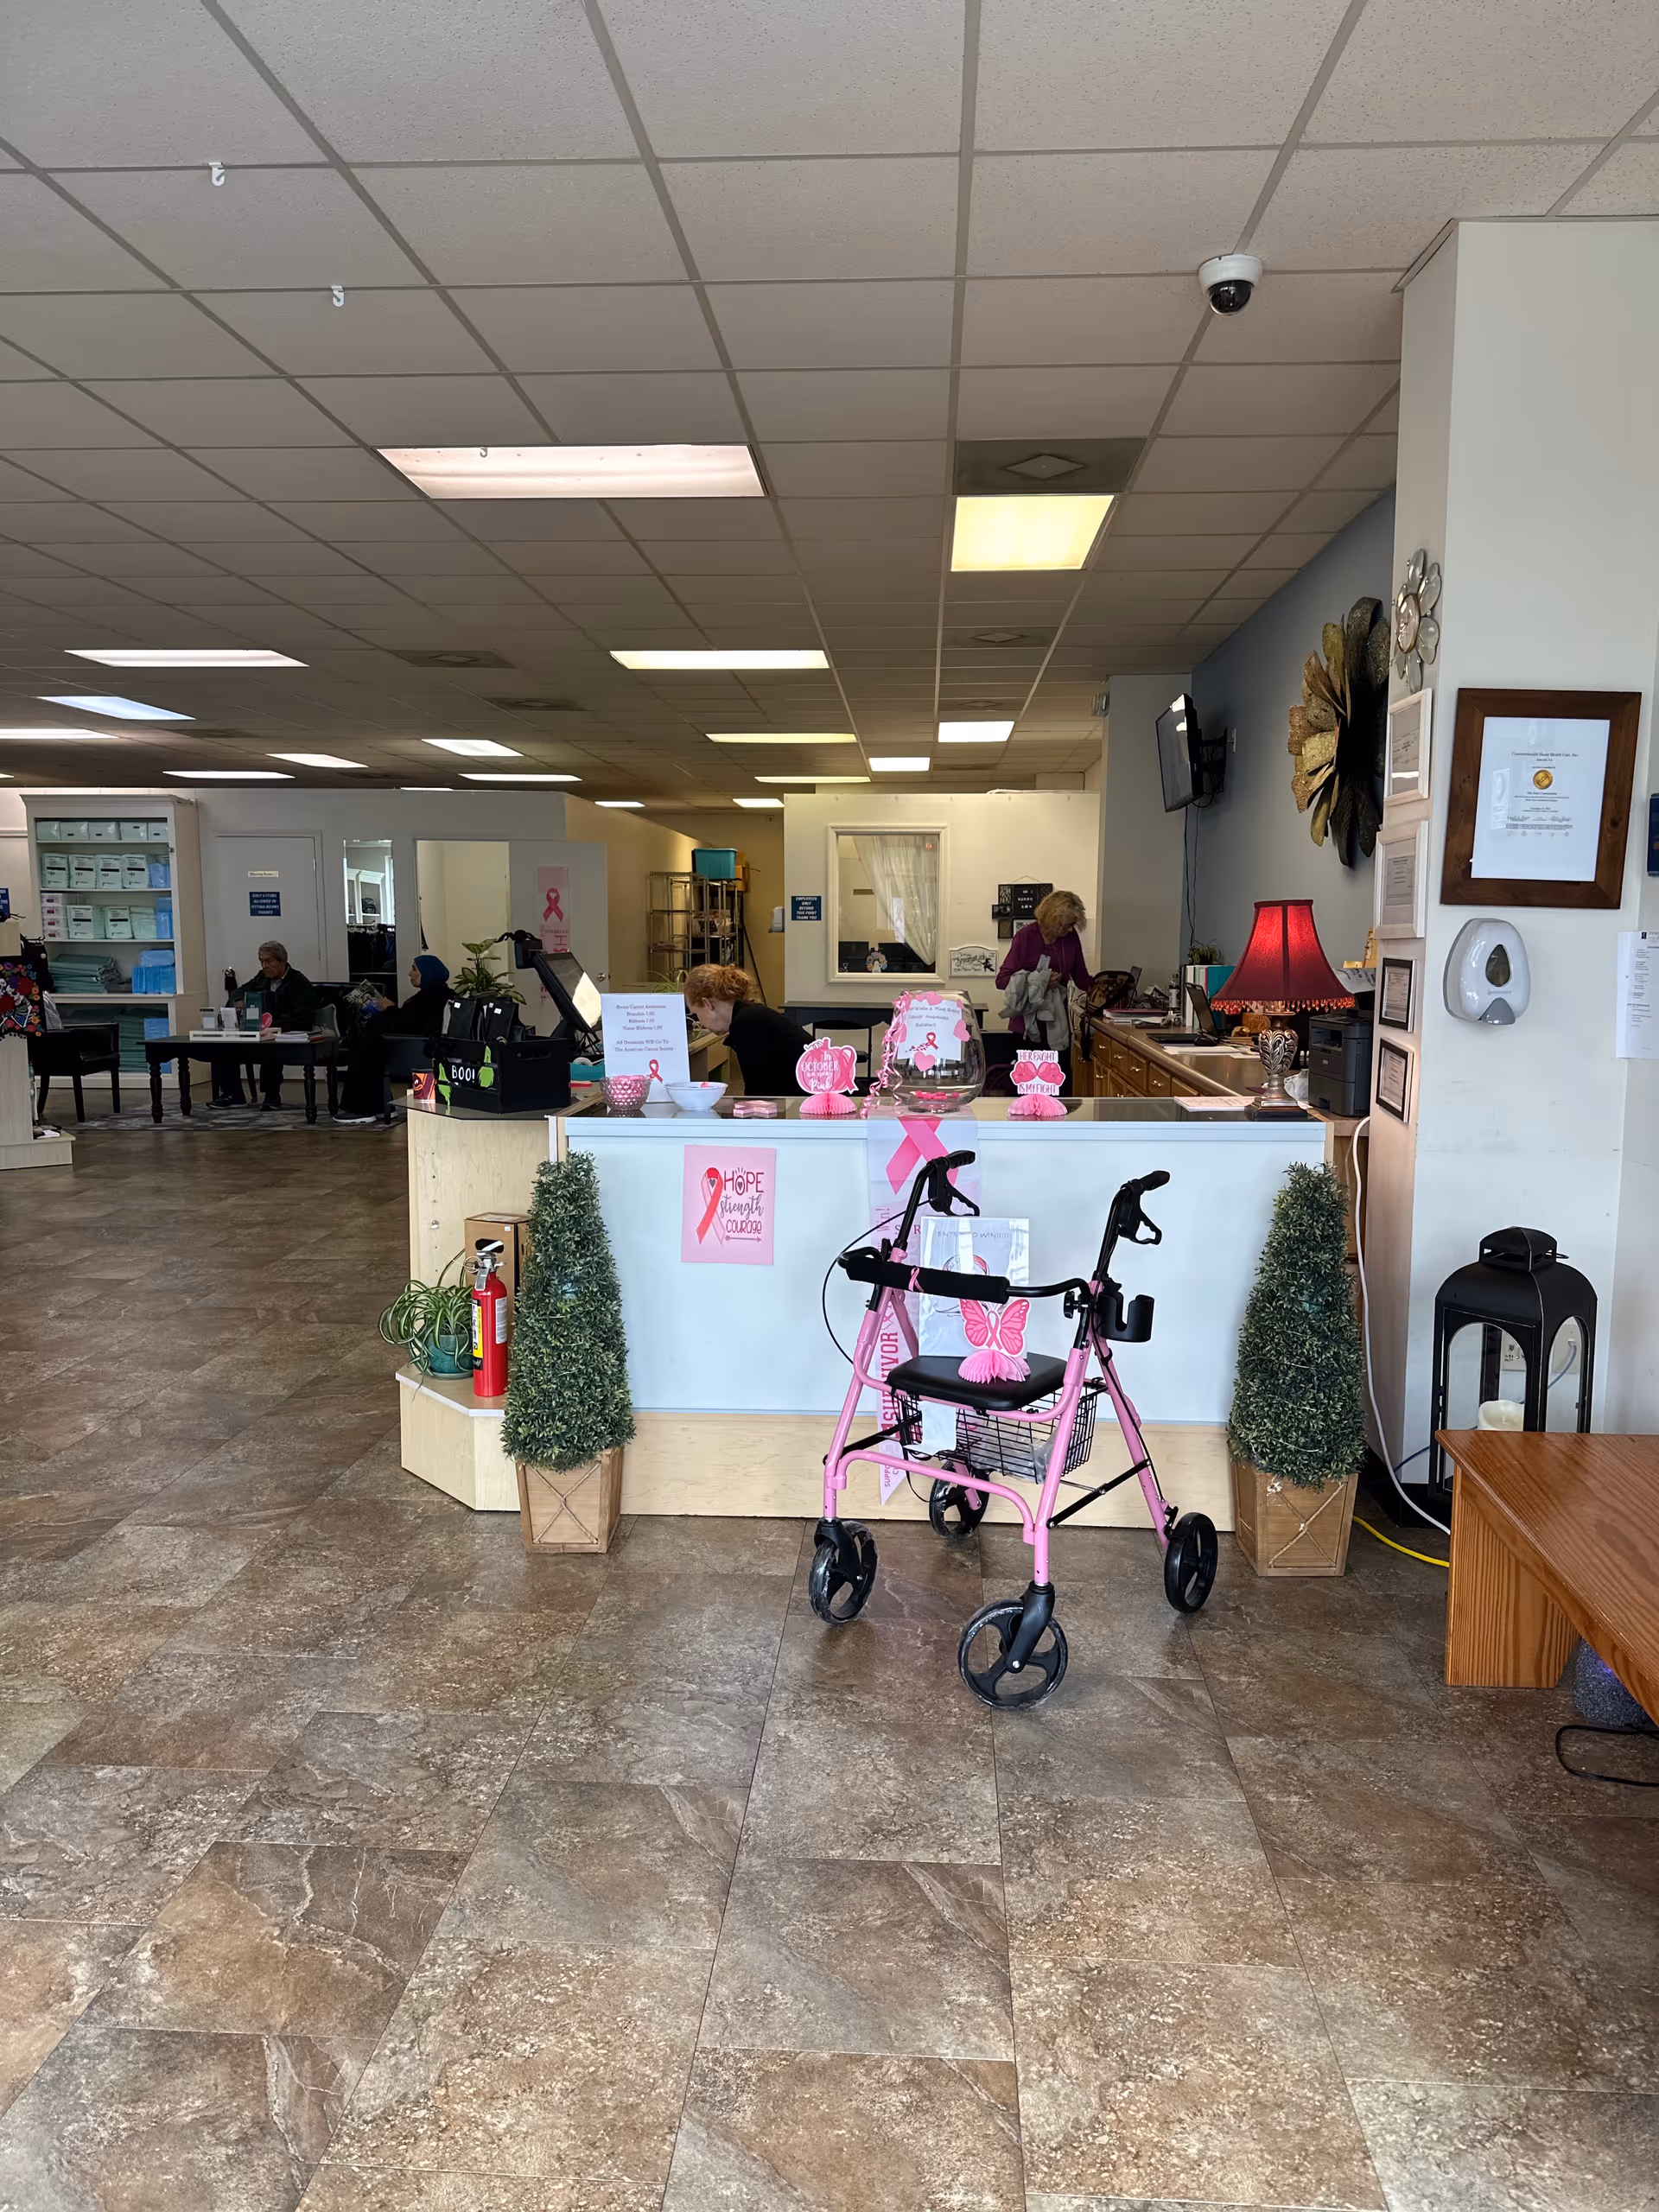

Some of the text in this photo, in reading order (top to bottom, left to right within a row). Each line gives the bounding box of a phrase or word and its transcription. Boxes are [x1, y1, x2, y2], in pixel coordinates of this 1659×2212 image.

[824, 1051, 831, 1061] In
[1020, 1052, 1033, 1061] HER
[451, 1065, 475, 1083] BOO!
[801, 1061, 839, 1071] OCTOBER
[810, 1077, 832, 1091] Pink
[1020, 1084, 1056, 1093] IS MY FIGHT
[724, 1170, 765, 1196] HOPE
[720, 1194, 764, 1220] strength
[875, 1209, 890, 1232] Wn!
[880, 1332, 899, 1421] SUIVOR
